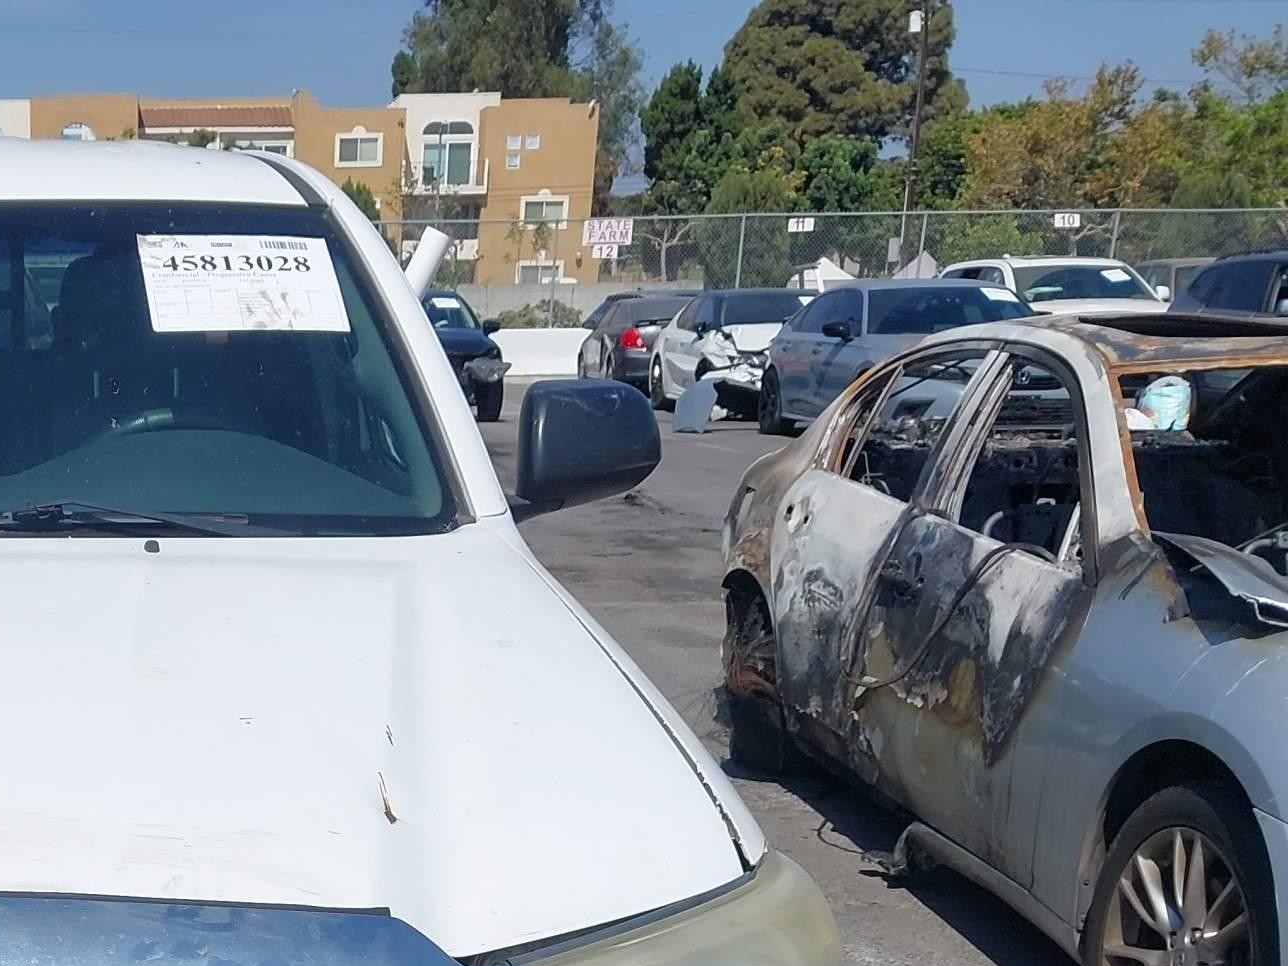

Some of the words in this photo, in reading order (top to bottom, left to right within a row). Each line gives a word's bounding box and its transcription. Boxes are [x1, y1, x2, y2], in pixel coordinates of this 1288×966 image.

[587, 220, 631, 230] STATE
[794, 217, 805, 230] 11
[1060, 214, 1075, 226] 10
[588, 230, 629, 241] FARM
[597, 245, 614, 257] 12
[162, 254, 311, 273] 45813028
